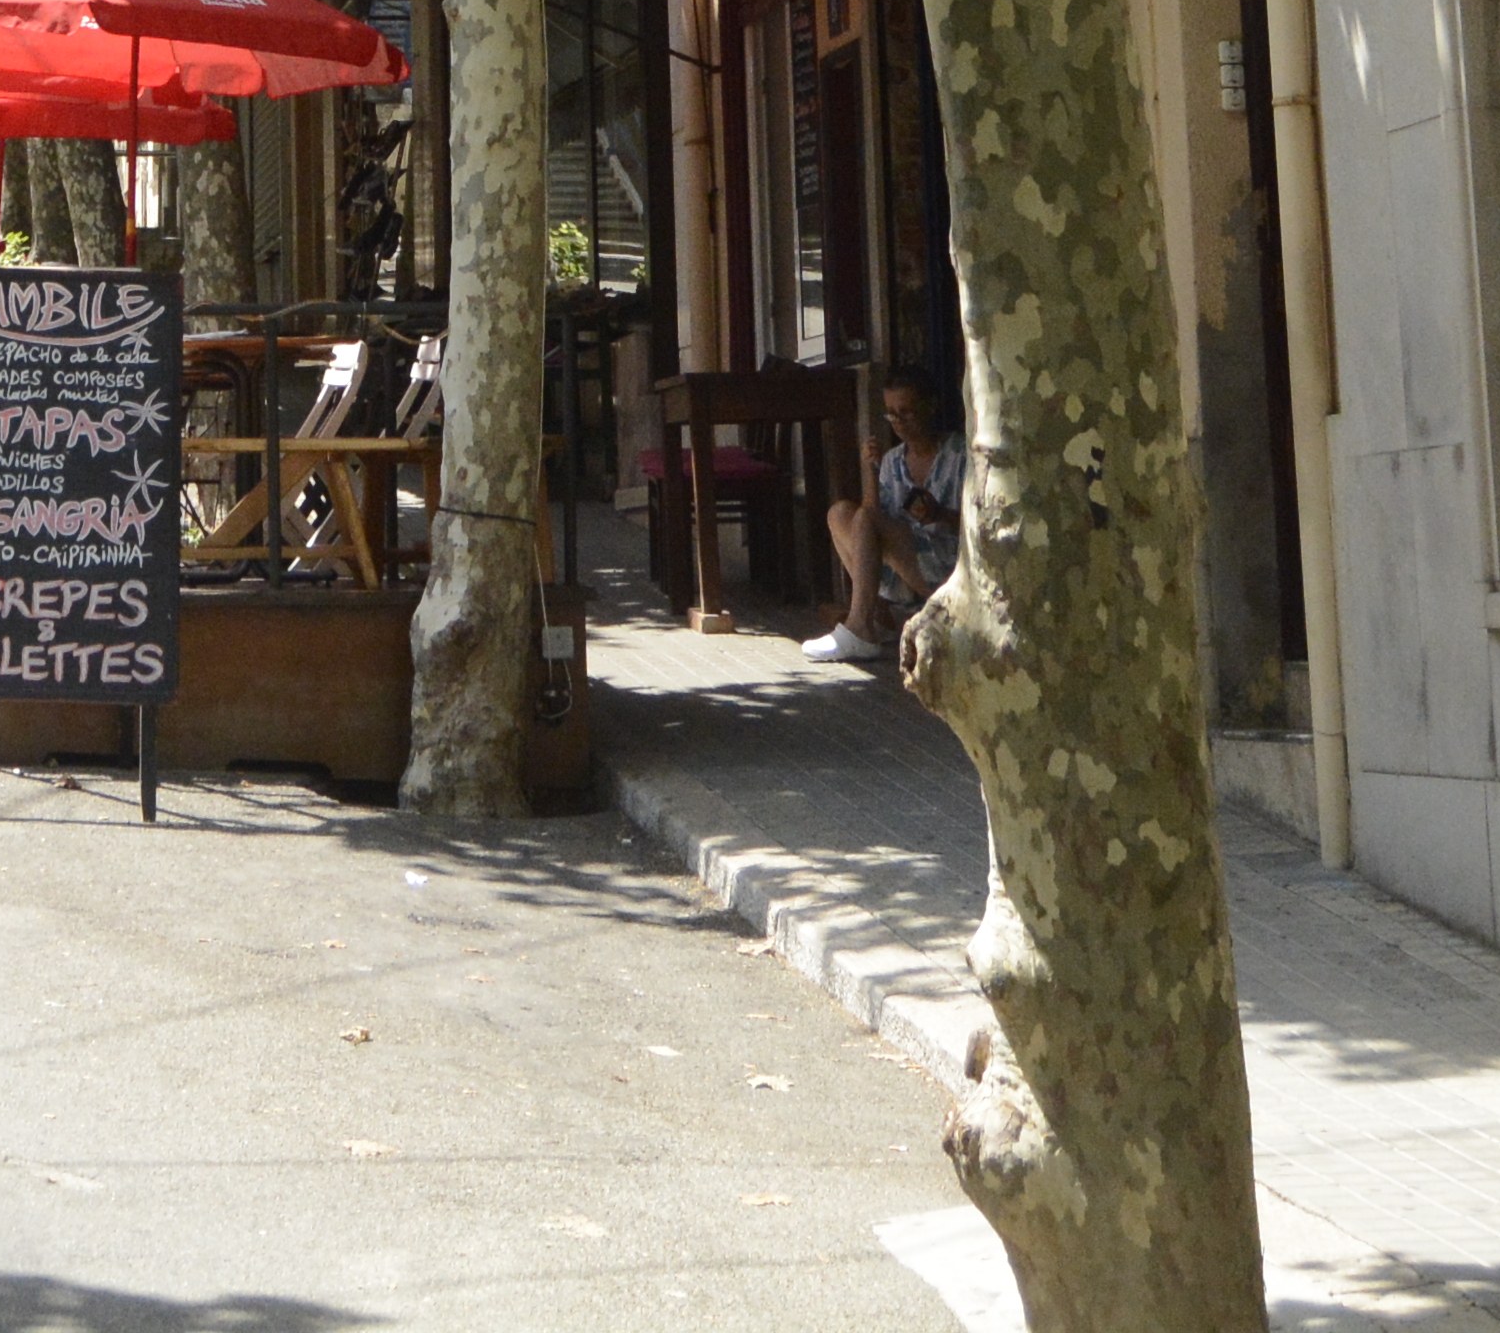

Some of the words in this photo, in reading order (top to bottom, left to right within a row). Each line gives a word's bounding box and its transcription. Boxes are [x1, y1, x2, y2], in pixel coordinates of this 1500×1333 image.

[69, 347, 89, 363] de
[91, 346, 112, 363] la
[53, 367, 145, 389] COMPOSÉES
